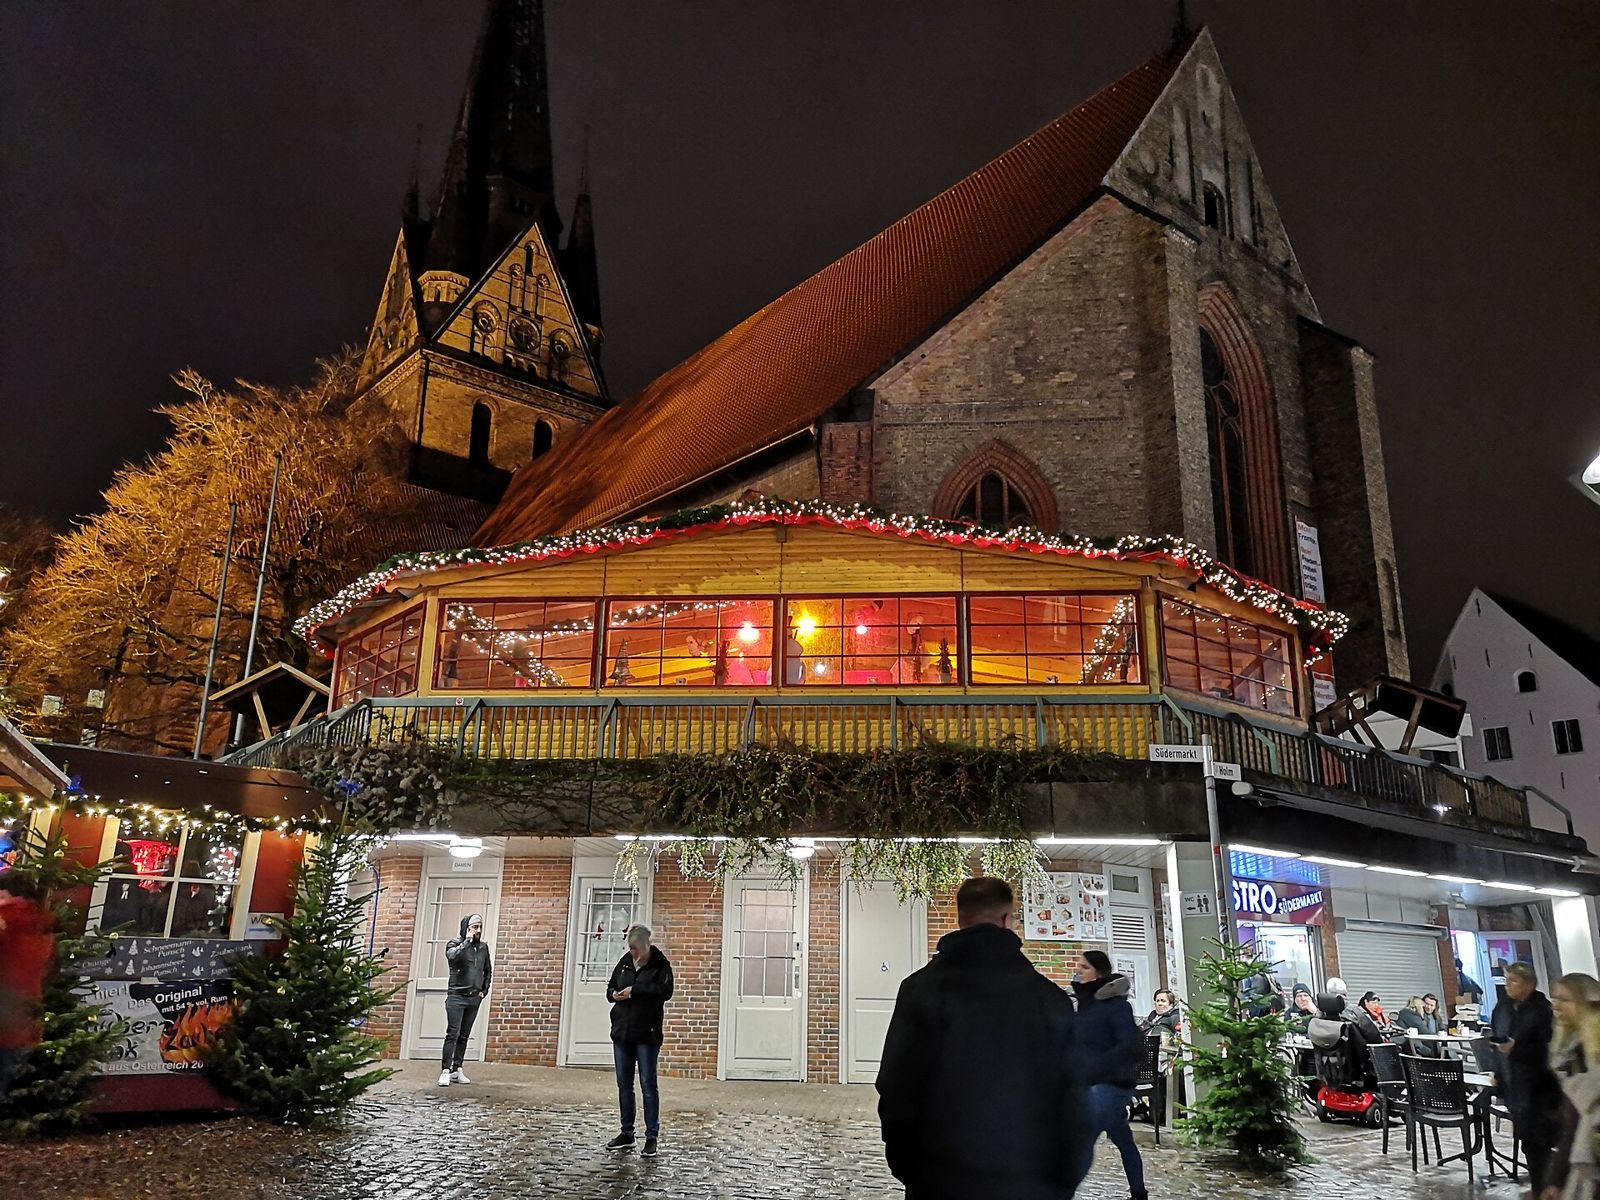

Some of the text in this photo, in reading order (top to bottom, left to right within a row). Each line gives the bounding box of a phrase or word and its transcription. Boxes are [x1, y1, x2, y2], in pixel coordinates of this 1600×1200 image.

[1155, 747, 1197, 759] Südermarkt
[1218, 765, 1234, 776] Holm
[1232, 879, 1323, 914] STRO SÜDERMARKT
[158, 947, 185, 958] Punsch
[128, 985, 203, 1010] Das Original
[161, 1005, 175, 1014] mit
[175, 1003, 186, 1011] 54
[210, 995, 228, 1004] Rum
[108, 1064, 129, 1072] aus
